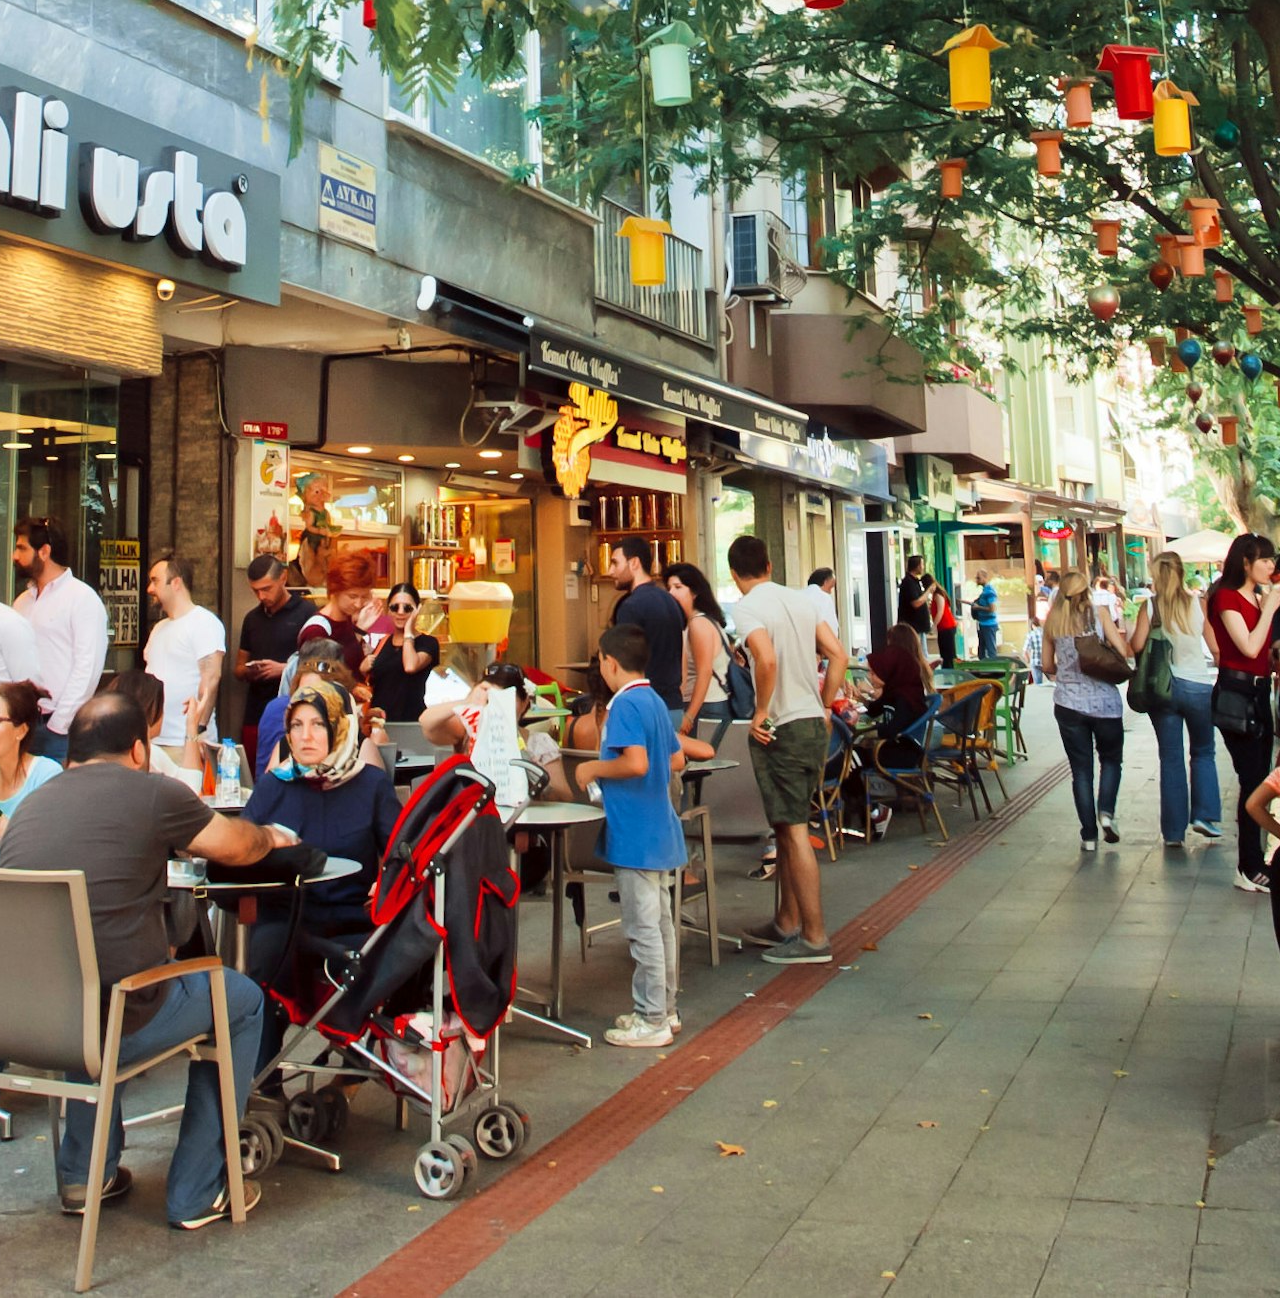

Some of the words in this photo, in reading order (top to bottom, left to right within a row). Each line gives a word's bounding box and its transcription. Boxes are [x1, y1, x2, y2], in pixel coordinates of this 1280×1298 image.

[92, 150, 248, 266] usta
[336, 184, 374, 213] AYKAR
[589, 356, 619, 389] Waffles
[99, 568, 139, 592] CULHA
